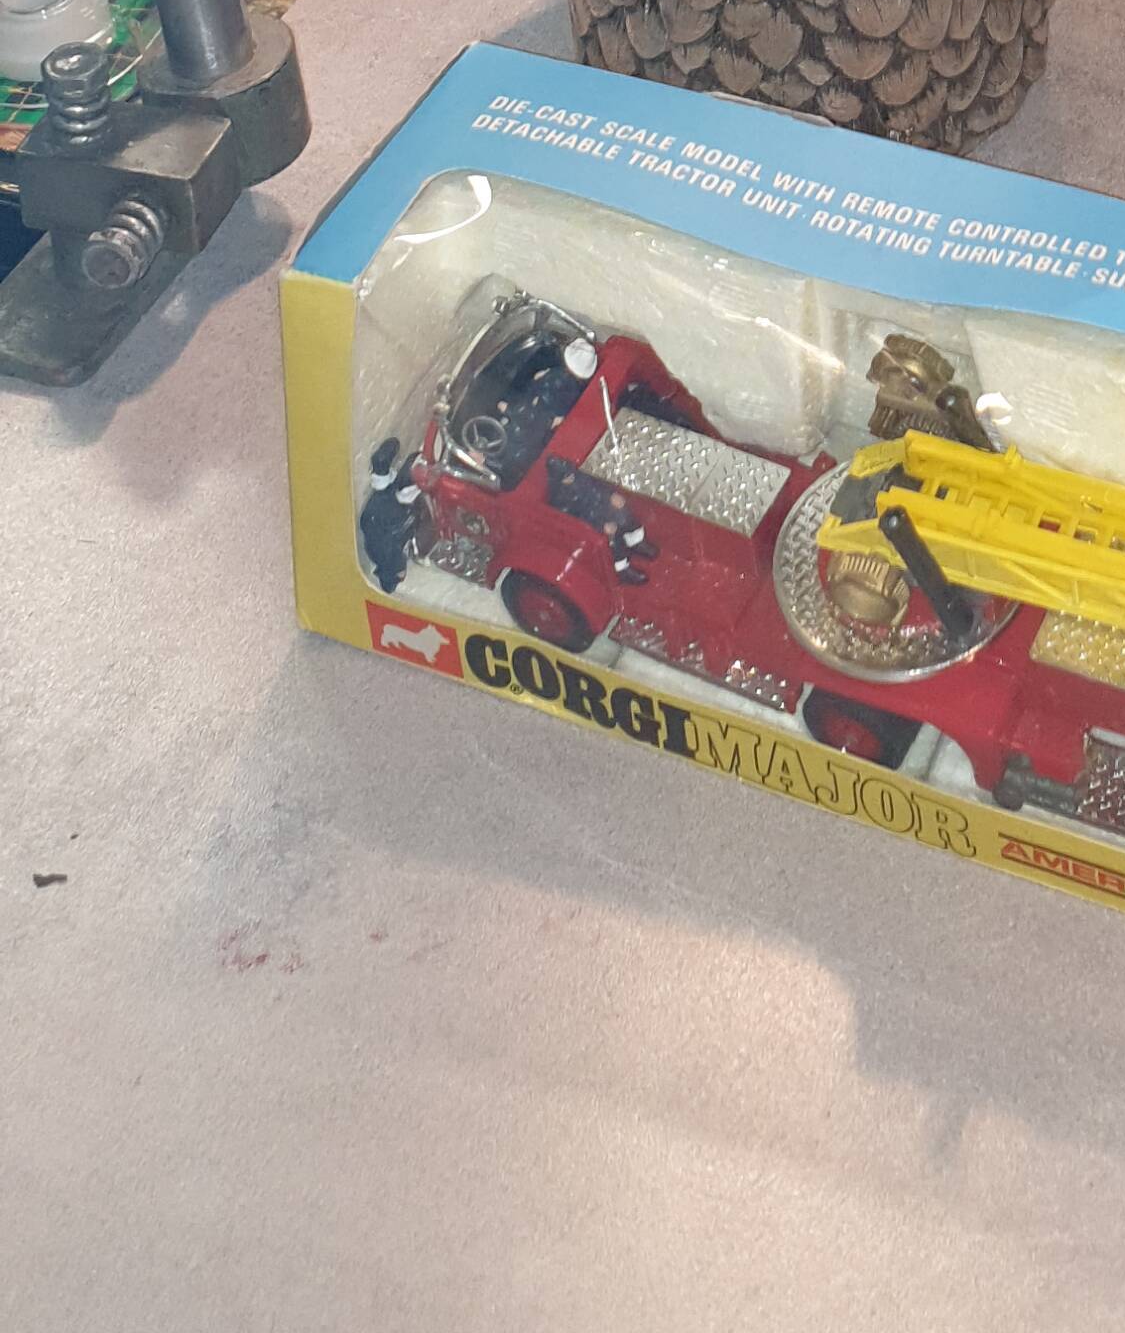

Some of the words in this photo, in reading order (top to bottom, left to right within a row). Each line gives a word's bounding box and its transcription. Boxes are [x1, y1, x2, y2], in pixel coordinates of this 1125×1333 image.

[471, 113, 623, 160] DETACHABLE
[628, 149, 737, 198] TRACTOR
[742, 187, 803, 220] UNIT
[809, 209, 932, 256] ROTATING
[938, 239, 1082, 279] TURNTABLE
[488, 95, 598, 130] DIE-CAST
[600, 121, 676, 151] SCALE
[681, 141, 762, 181] MODEL
[773, 171, 836, 204] WITH
[841, 191, 942, 232] REMOTE
[948, 217, 1107, 261] CONTROLLED
